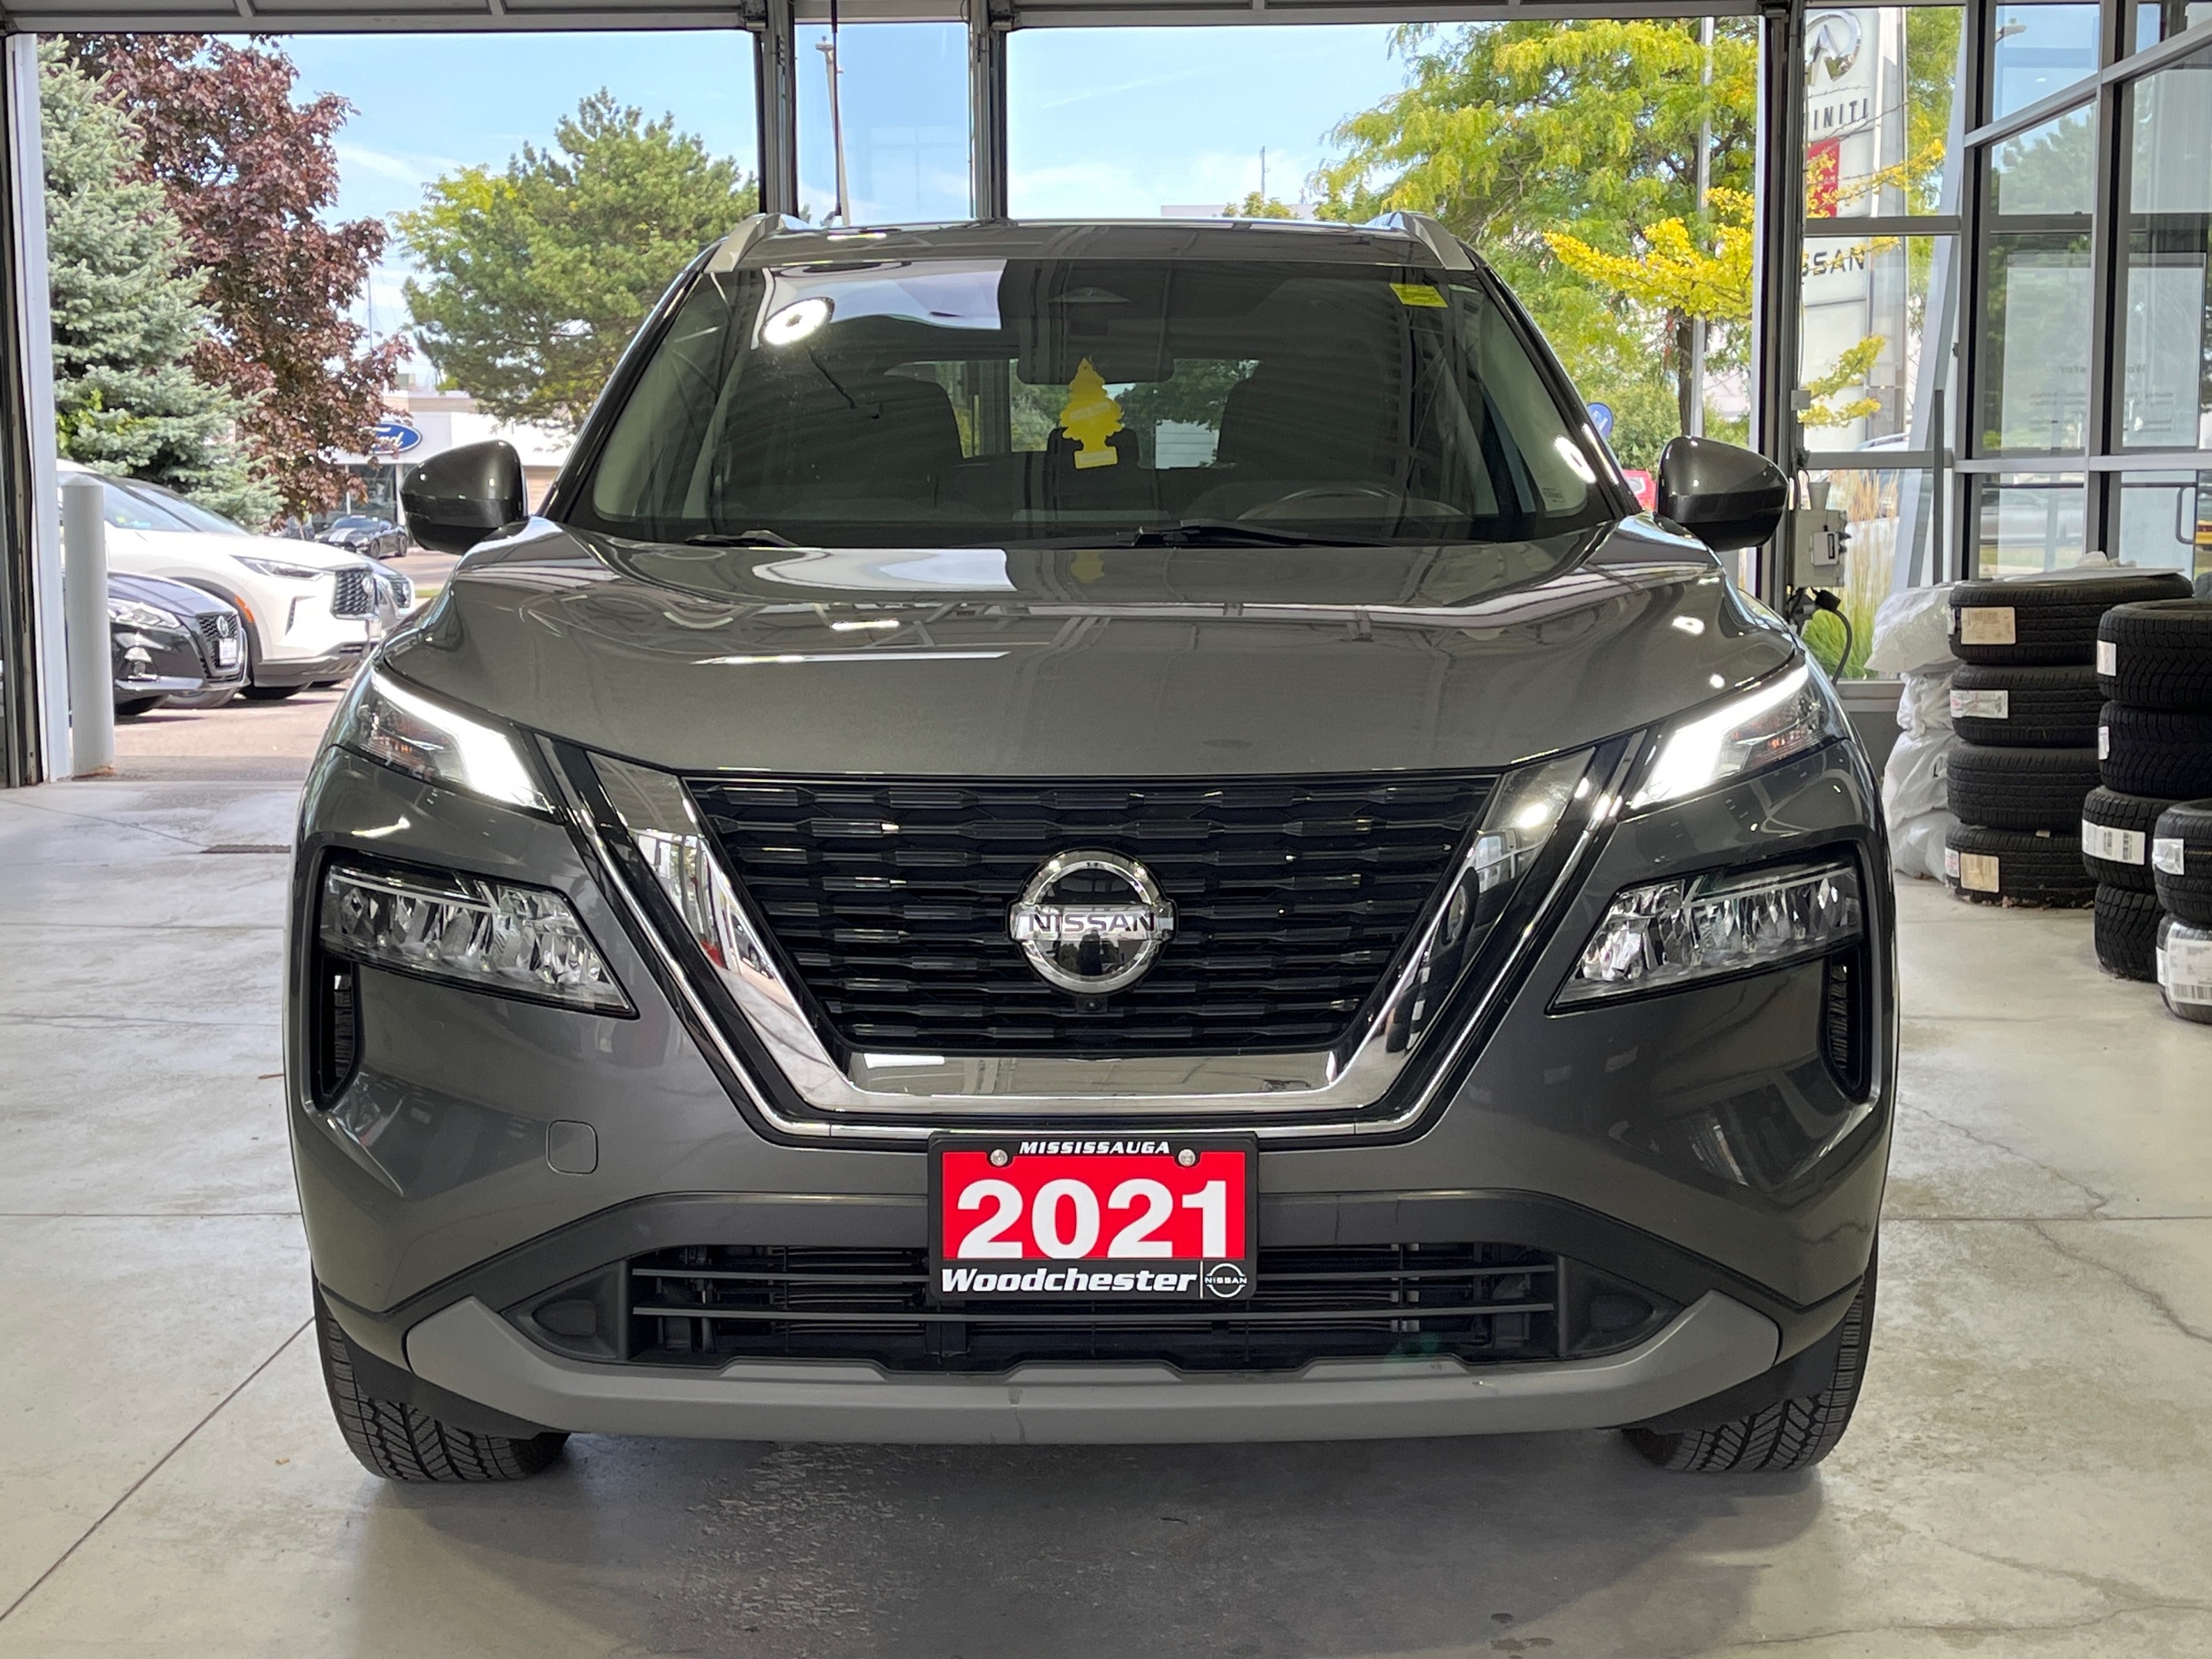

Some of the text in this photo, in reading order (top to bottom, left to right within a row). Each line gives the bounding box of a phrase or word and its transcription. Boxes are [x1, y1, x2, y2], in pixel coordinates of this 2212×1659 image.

[1813, 98, 1868, 131] INITI
[1028, 912, 1156, 932] NISSAN
[1018, 1141, 1171, 1154] MISSISSAUGA
[957, 1178, 1227, 1260] 2021
[941, 1267, 1198, 1293] Woodchester
[1204, 1276, 1247, 1284] NISSAN
